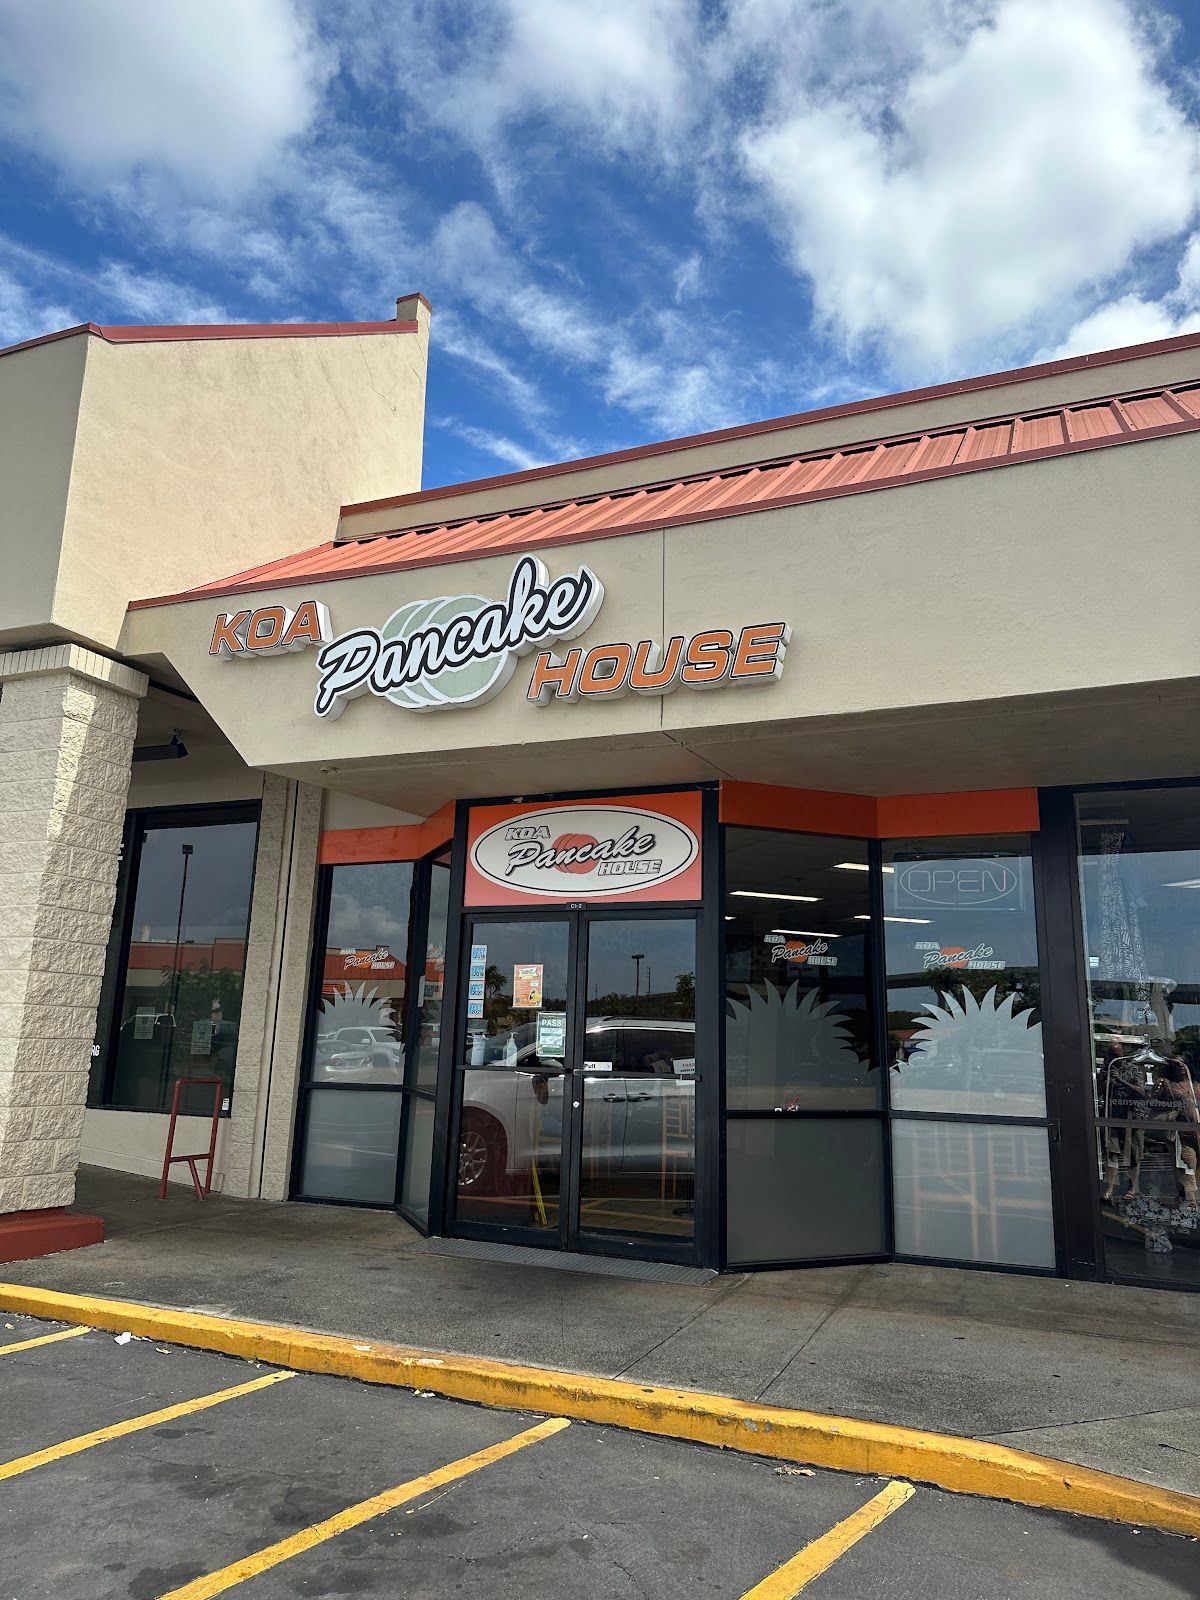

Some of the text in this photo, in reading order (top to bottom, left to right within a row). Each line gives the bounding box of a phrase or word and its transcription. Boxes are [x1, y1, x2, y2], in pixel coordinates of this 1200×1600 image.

[208, 600, 326, 658] KOA
[314, 553, 597, 717] Pancake
[526, 622, 787, 702] HOUSE
[505, 826, 551, 841] KOA
[505, 826, 655, 876] Pancake
[598, 859, 663, 876] HOUSE
[907, 870, 1008, 892] OPEN
[344, 948, 389, 970] Pancake
[771, 939, 828, 963] Pancake
[923, 943, 994, 969] Pancake
[541, 1019, 562, 1027] PASS
